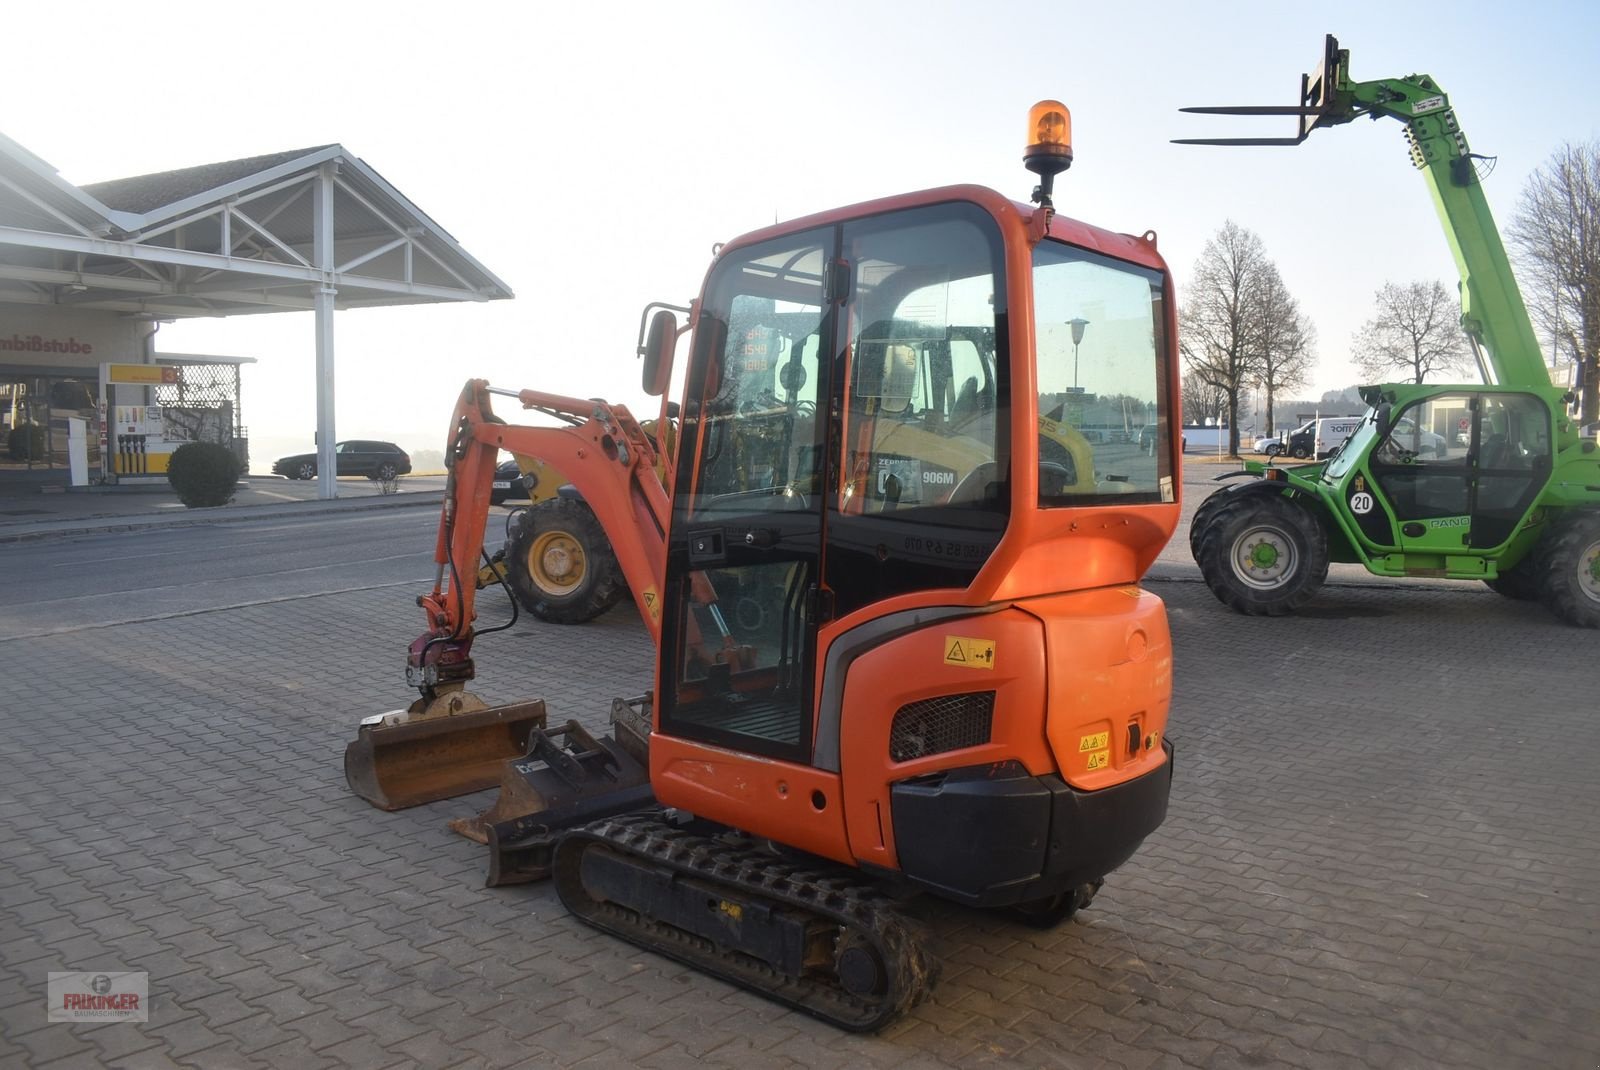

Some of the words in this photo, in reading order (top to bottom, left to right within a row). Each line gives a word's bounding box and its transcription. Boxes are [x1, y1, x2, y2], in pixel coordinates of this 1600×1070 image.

[0, 334, 92, 354] mbißstube
[165, 369, 174, 382] 3
[923, 471, 954, 485] 906M
[1354, 496, 1369, 510] 20
